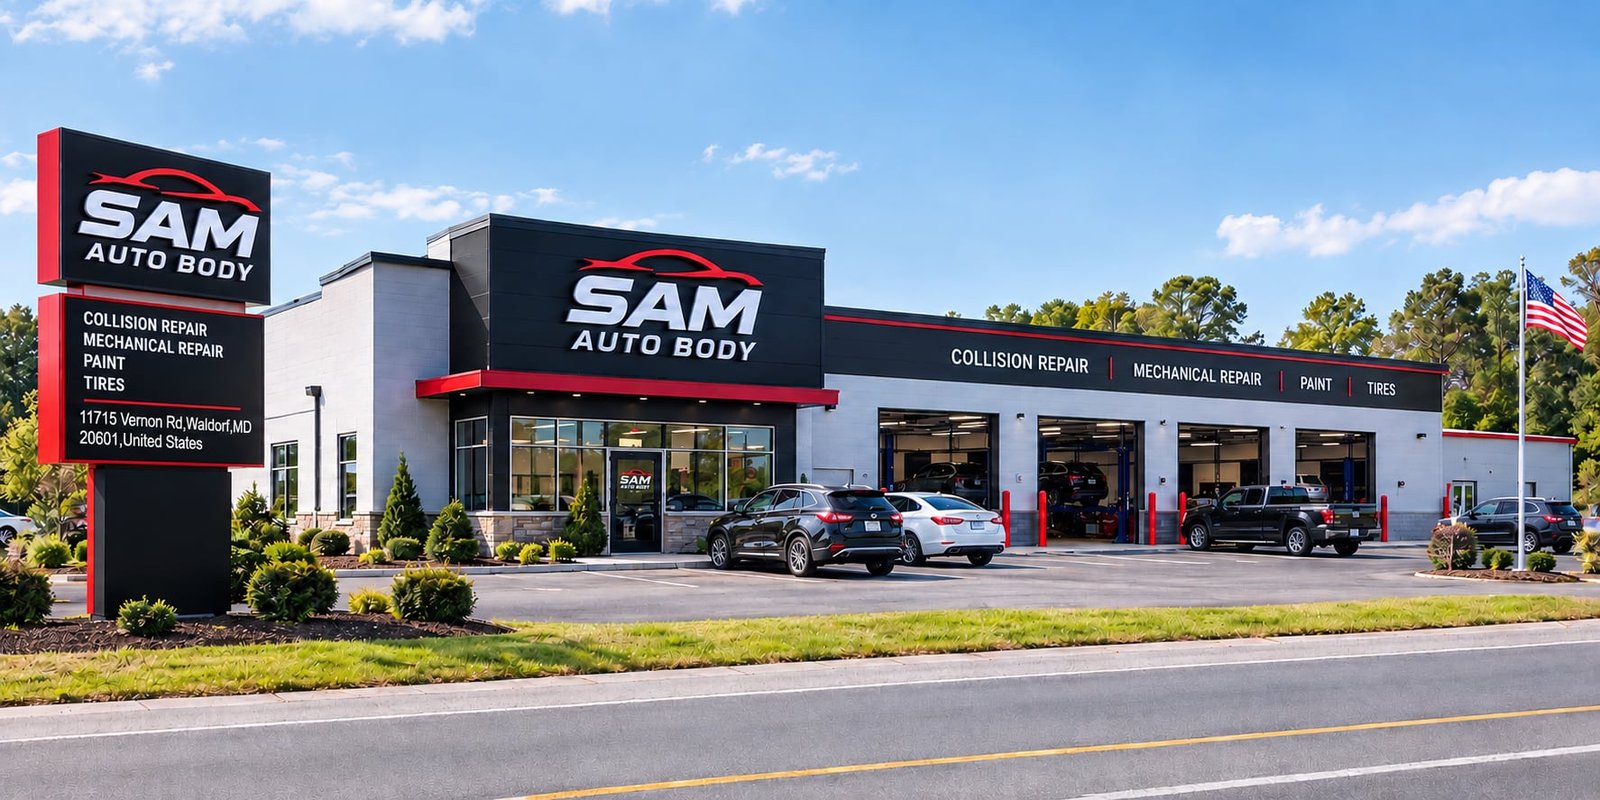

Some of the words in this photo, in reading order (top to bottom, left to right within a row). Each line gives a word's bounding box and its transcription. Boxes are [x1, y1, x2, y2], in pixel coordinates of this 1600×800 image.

[77, 190, 259, 258] SAM
[84, 243, 167, 269] AUTO
[176, 254, 254, 281] BODY
[565, 275, 762, 335] SAM
[84, 311, 157, 332] COLLISION
[162, 320, 208, 336] REPAIR
[84, 332, 175, 354] MECHANICAL
[179, 342, 224, 358] REPAIR
[570, 330, 661, 354] AUTO
[673, 337, 757, 361] BODY
[84, 354, 126, 370] PAINT
[951, 348, 1033, 370] COLLISION
[1038, 355, 1089, 374] REPAIR
[1133, 363, 1217, 383] MECHANICAL
[1221, 370, 1262, 386] REPAIR
[1300, 376, 1333, 392] PAINT
[1366, 382, 1396, 396] TIRES
[84, 376, 125, 391] TIRES
[79, 410, 118, 426] 11715
[121, 412, 163, 428] Vernon
[167, 415, 252, 436] Rd,Waldorf,MD
[79, 430, 163, 449] 20601,United
[166, 435, 203, 450] States
[620, 475, 652, 485] SAM
